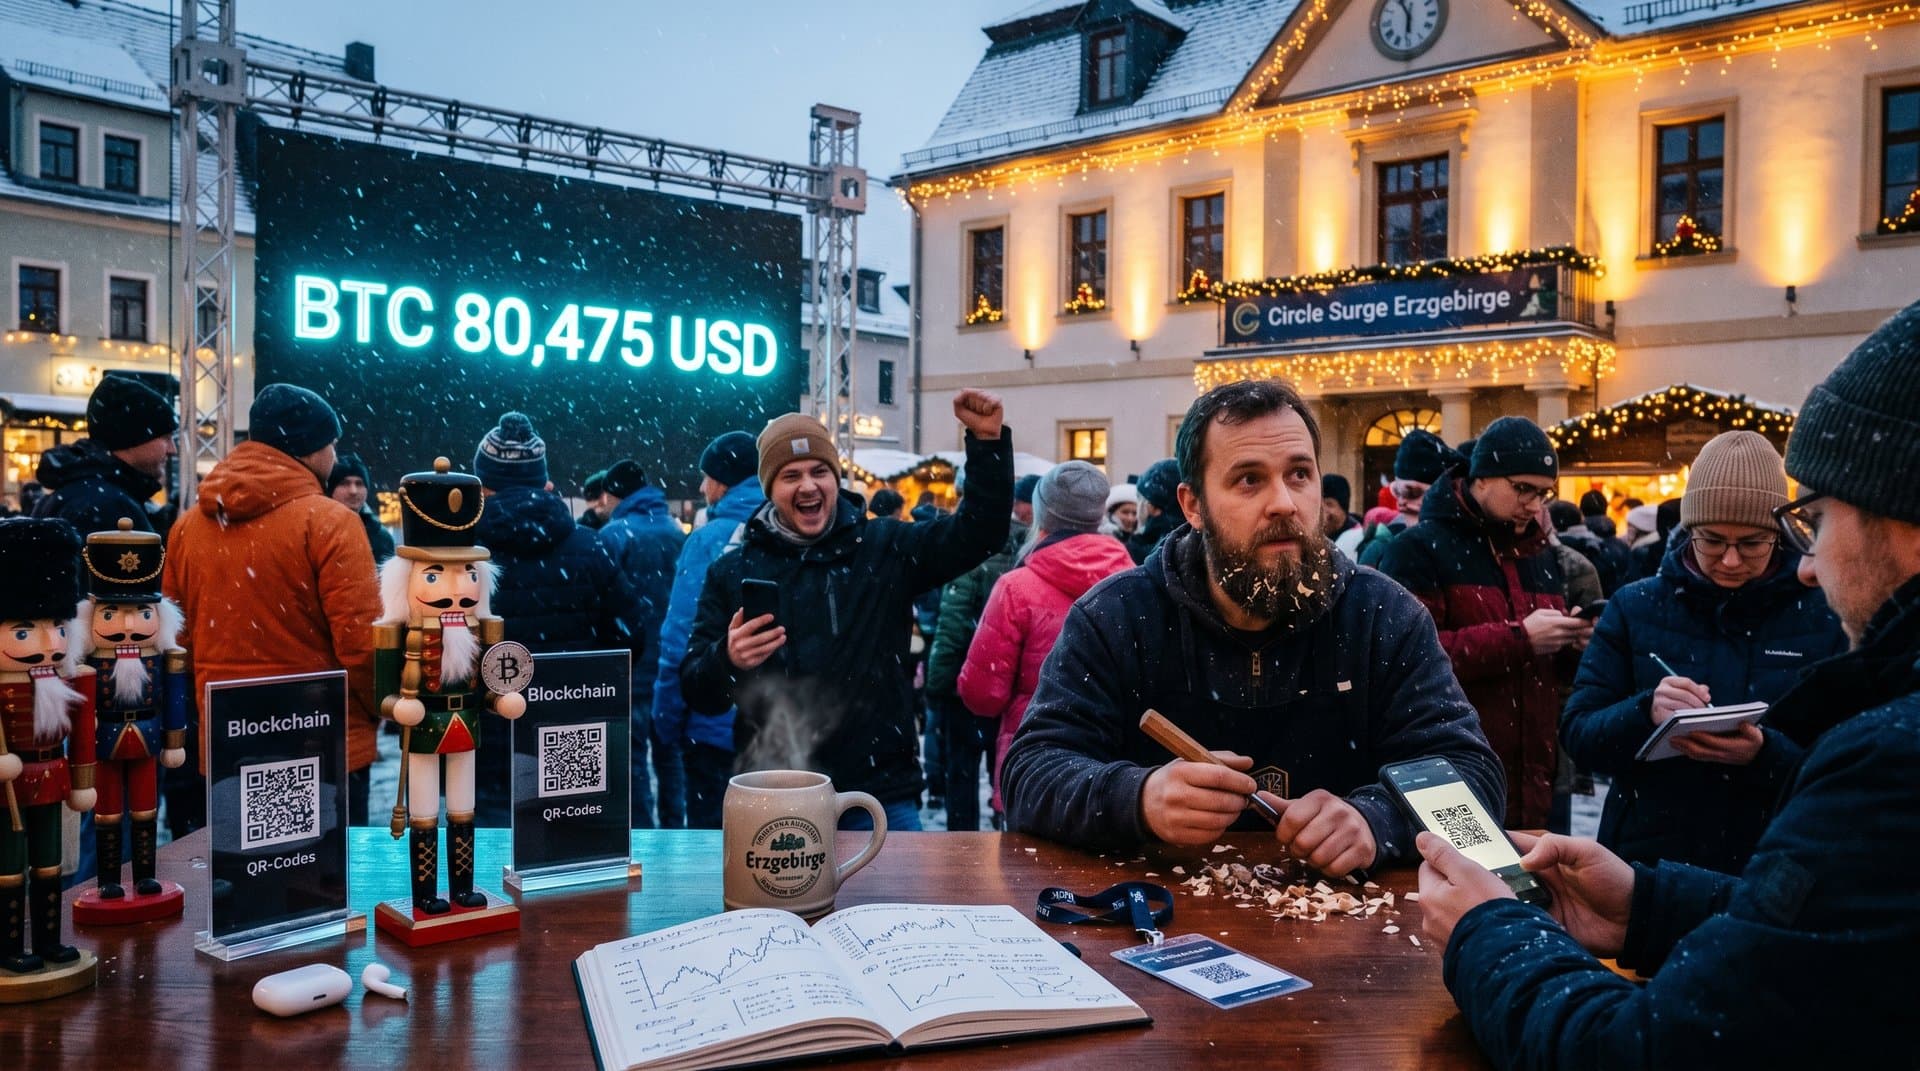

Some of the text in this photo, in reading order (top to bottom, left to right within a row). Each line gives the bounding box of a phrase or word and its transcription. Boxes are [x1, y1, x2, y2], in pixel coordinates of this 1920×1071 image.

[1268, 288, 1511, 327] Circle Surge Erzgebirge
[293, 274, 779, 377] BTC 80,475 USD
[528, 683, 616, 702] Blockchain
[227, 710, 331, 738] Blockchain
[543, 804, 603, 821] QR-Codes
[246, 851, 316, 876] QR-Codes
[745, 851, 826, 874] Erzgebirge
